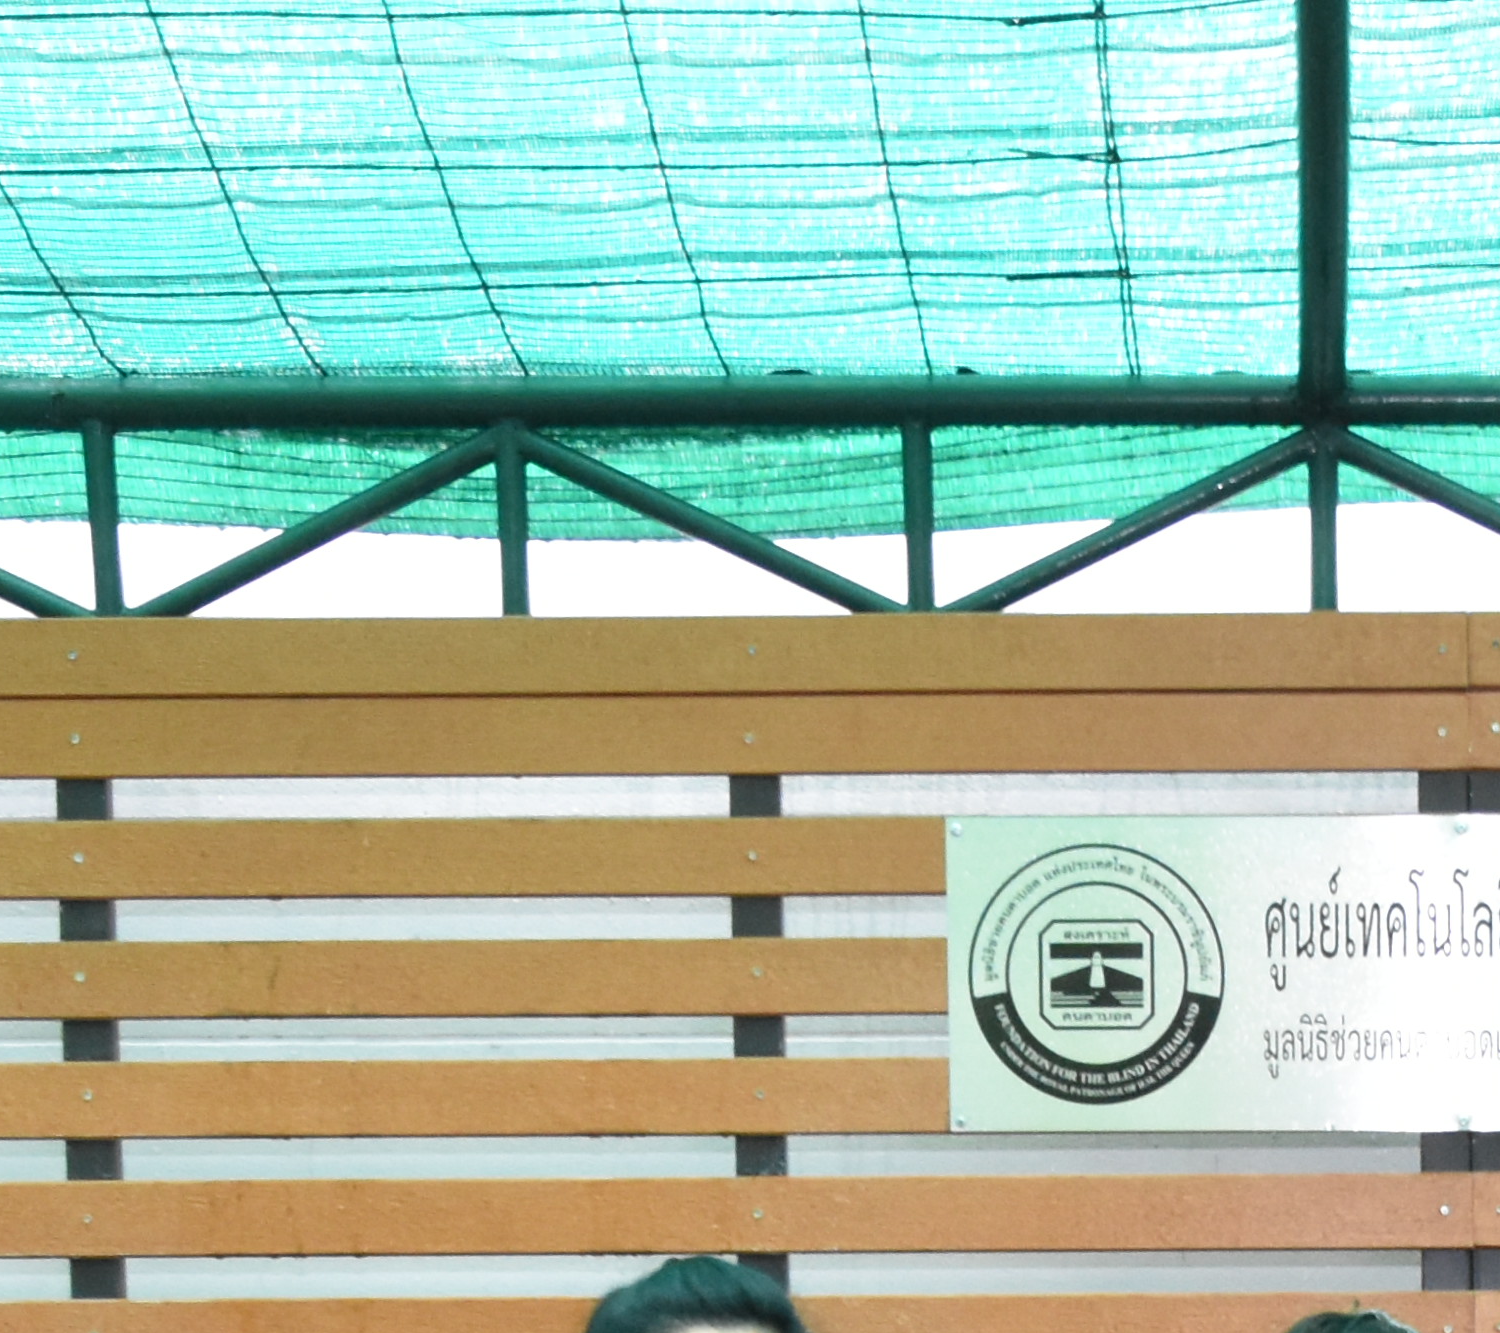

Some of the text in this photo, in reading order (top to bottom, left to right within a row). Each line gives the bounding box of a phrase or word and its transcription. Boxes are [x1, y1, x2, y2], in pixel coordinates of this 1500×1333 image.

[994, 1003, 1200, 1085] FOUNDATION FOR THE BLIND IN THAILAND
